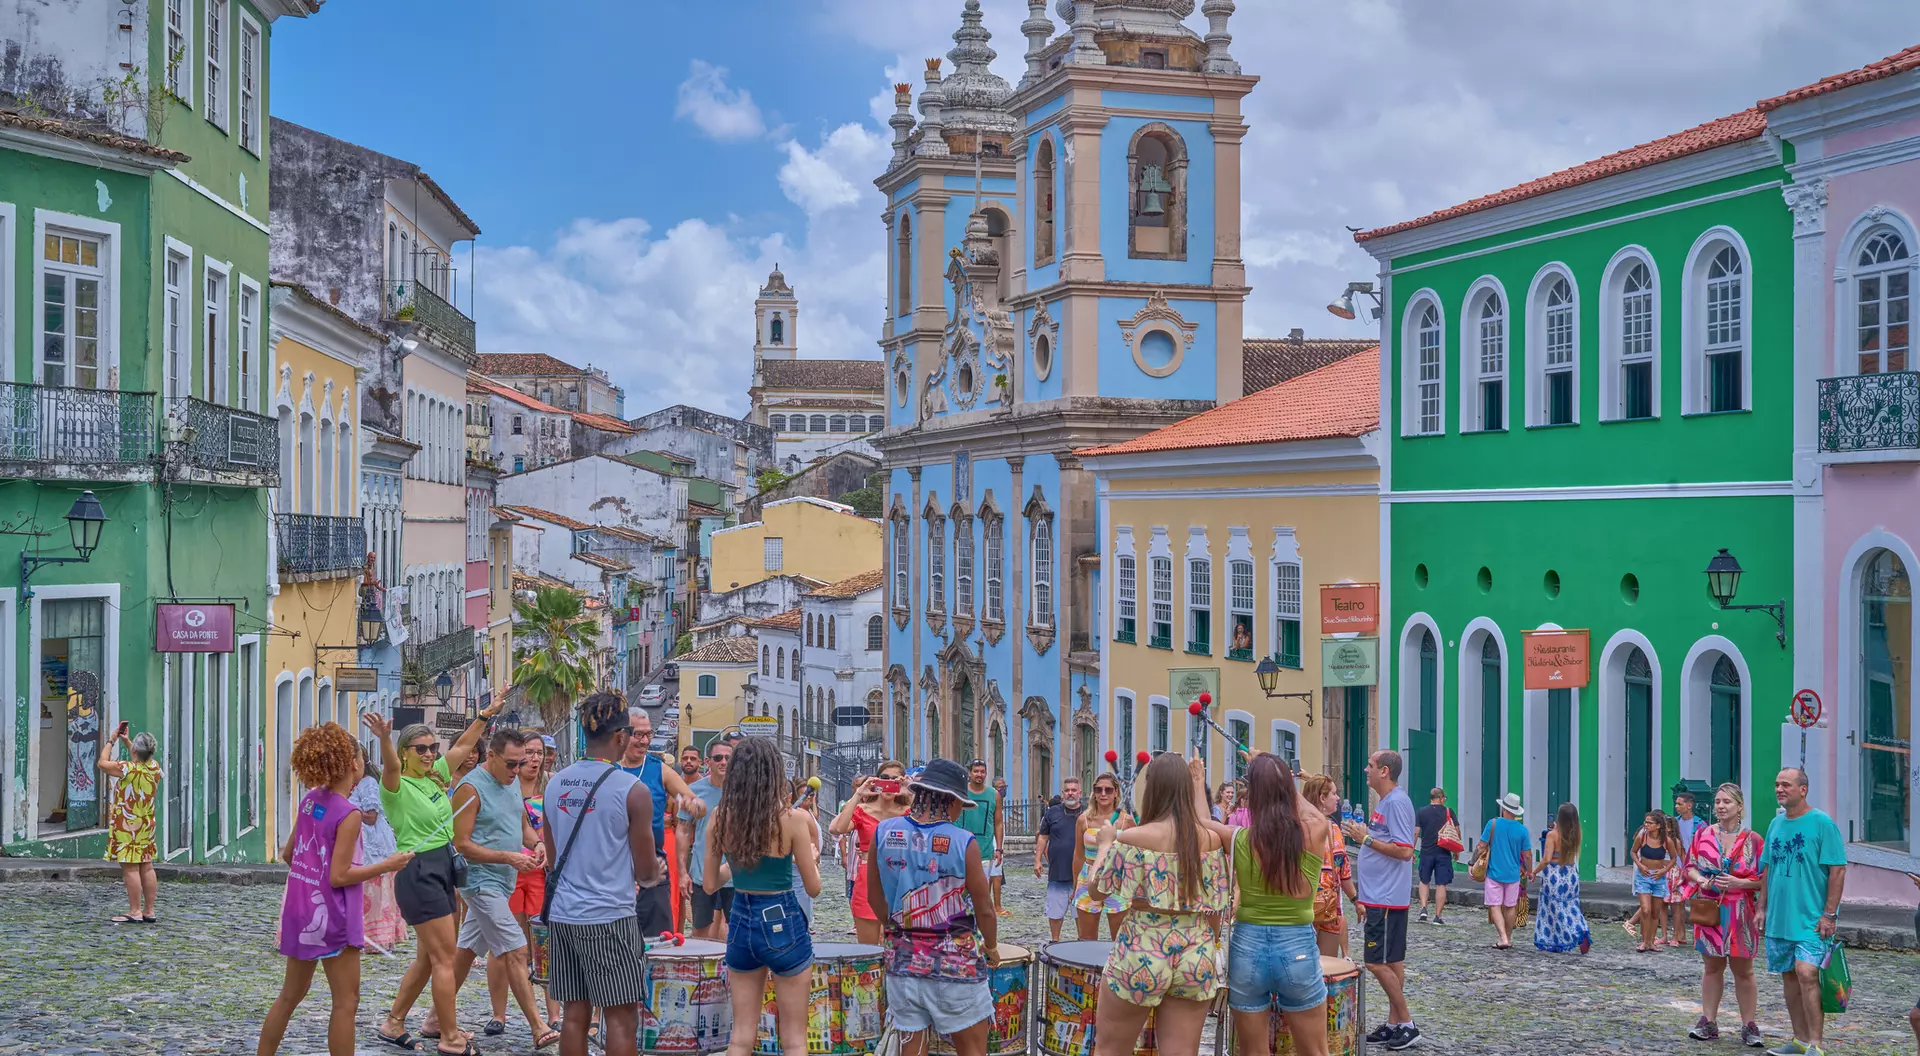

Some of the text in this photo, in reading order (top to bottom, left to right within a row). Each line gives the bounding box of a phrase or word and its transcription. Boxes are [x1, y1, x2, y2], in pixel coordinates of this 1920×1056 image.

[1331, 598, 1364, 611] Teatro
[172, 630, 219, 639] CASA DA PONTE
[1533, 644, 1576, 654] Restaurante
[560, 778, 597, 788] World Tea
[557, 798, 596, 809] CONTEMPOREA
